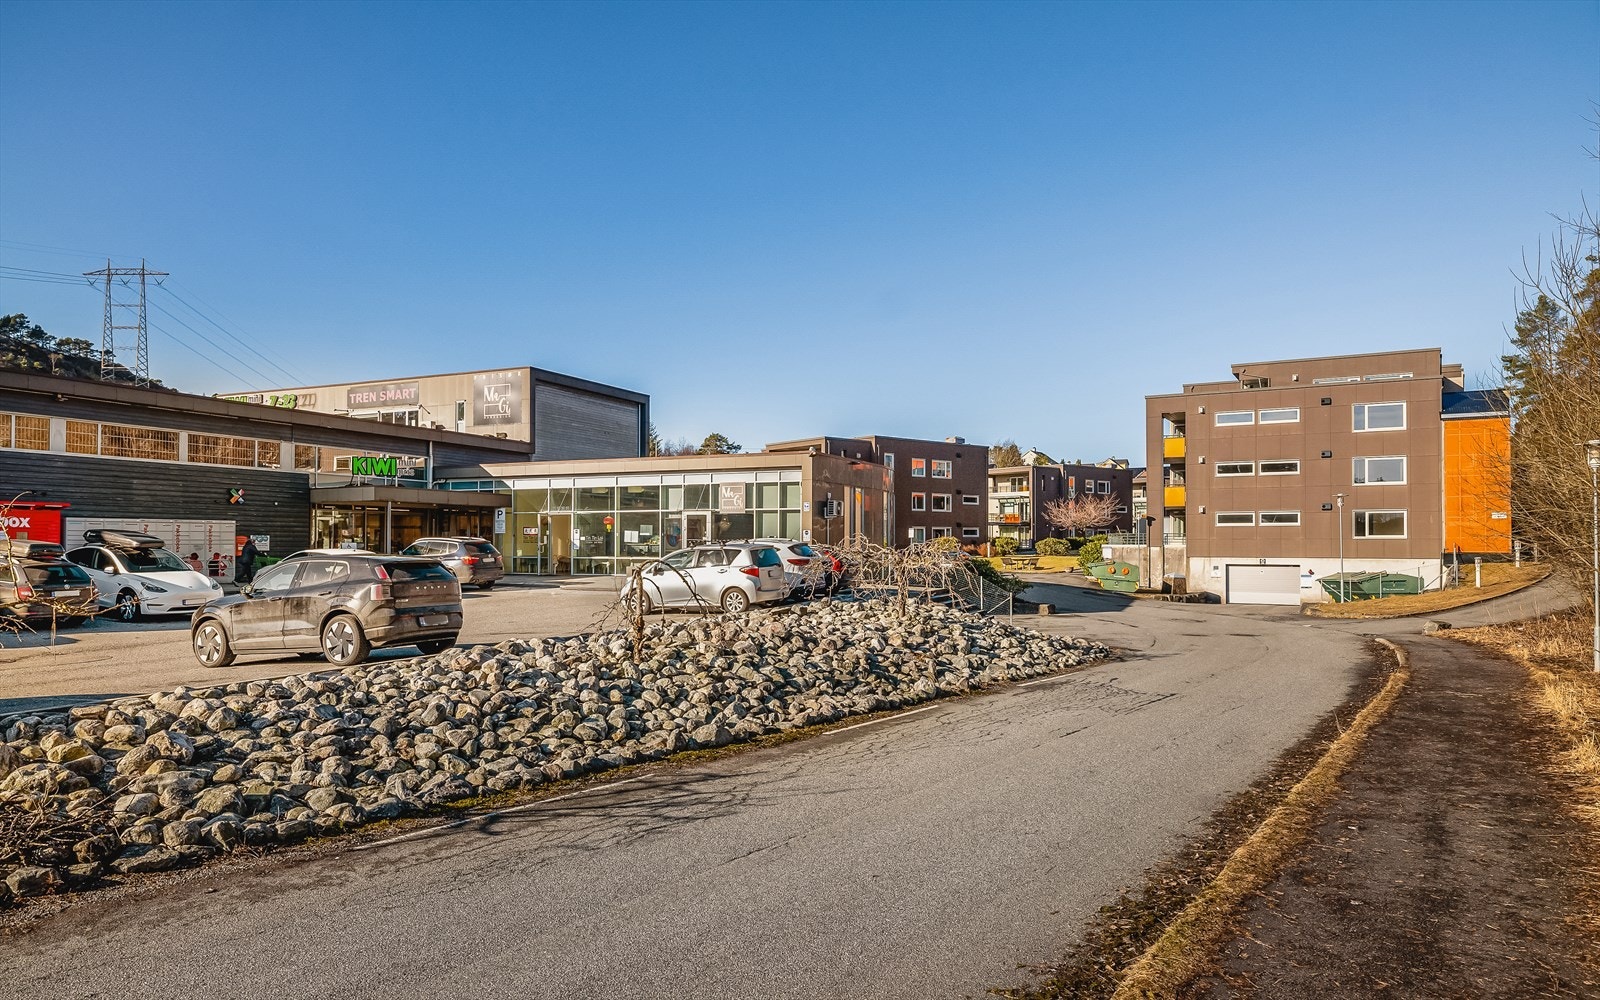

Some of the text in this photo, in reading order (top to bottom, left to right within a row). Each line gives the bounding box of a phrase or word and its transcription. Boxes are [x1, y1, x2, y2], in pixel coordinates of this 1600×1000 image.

[349, 388, 416, 403] TREN SMART
[352, 457, 397, 477] KIWI
[497, 510, 503, 519] P
